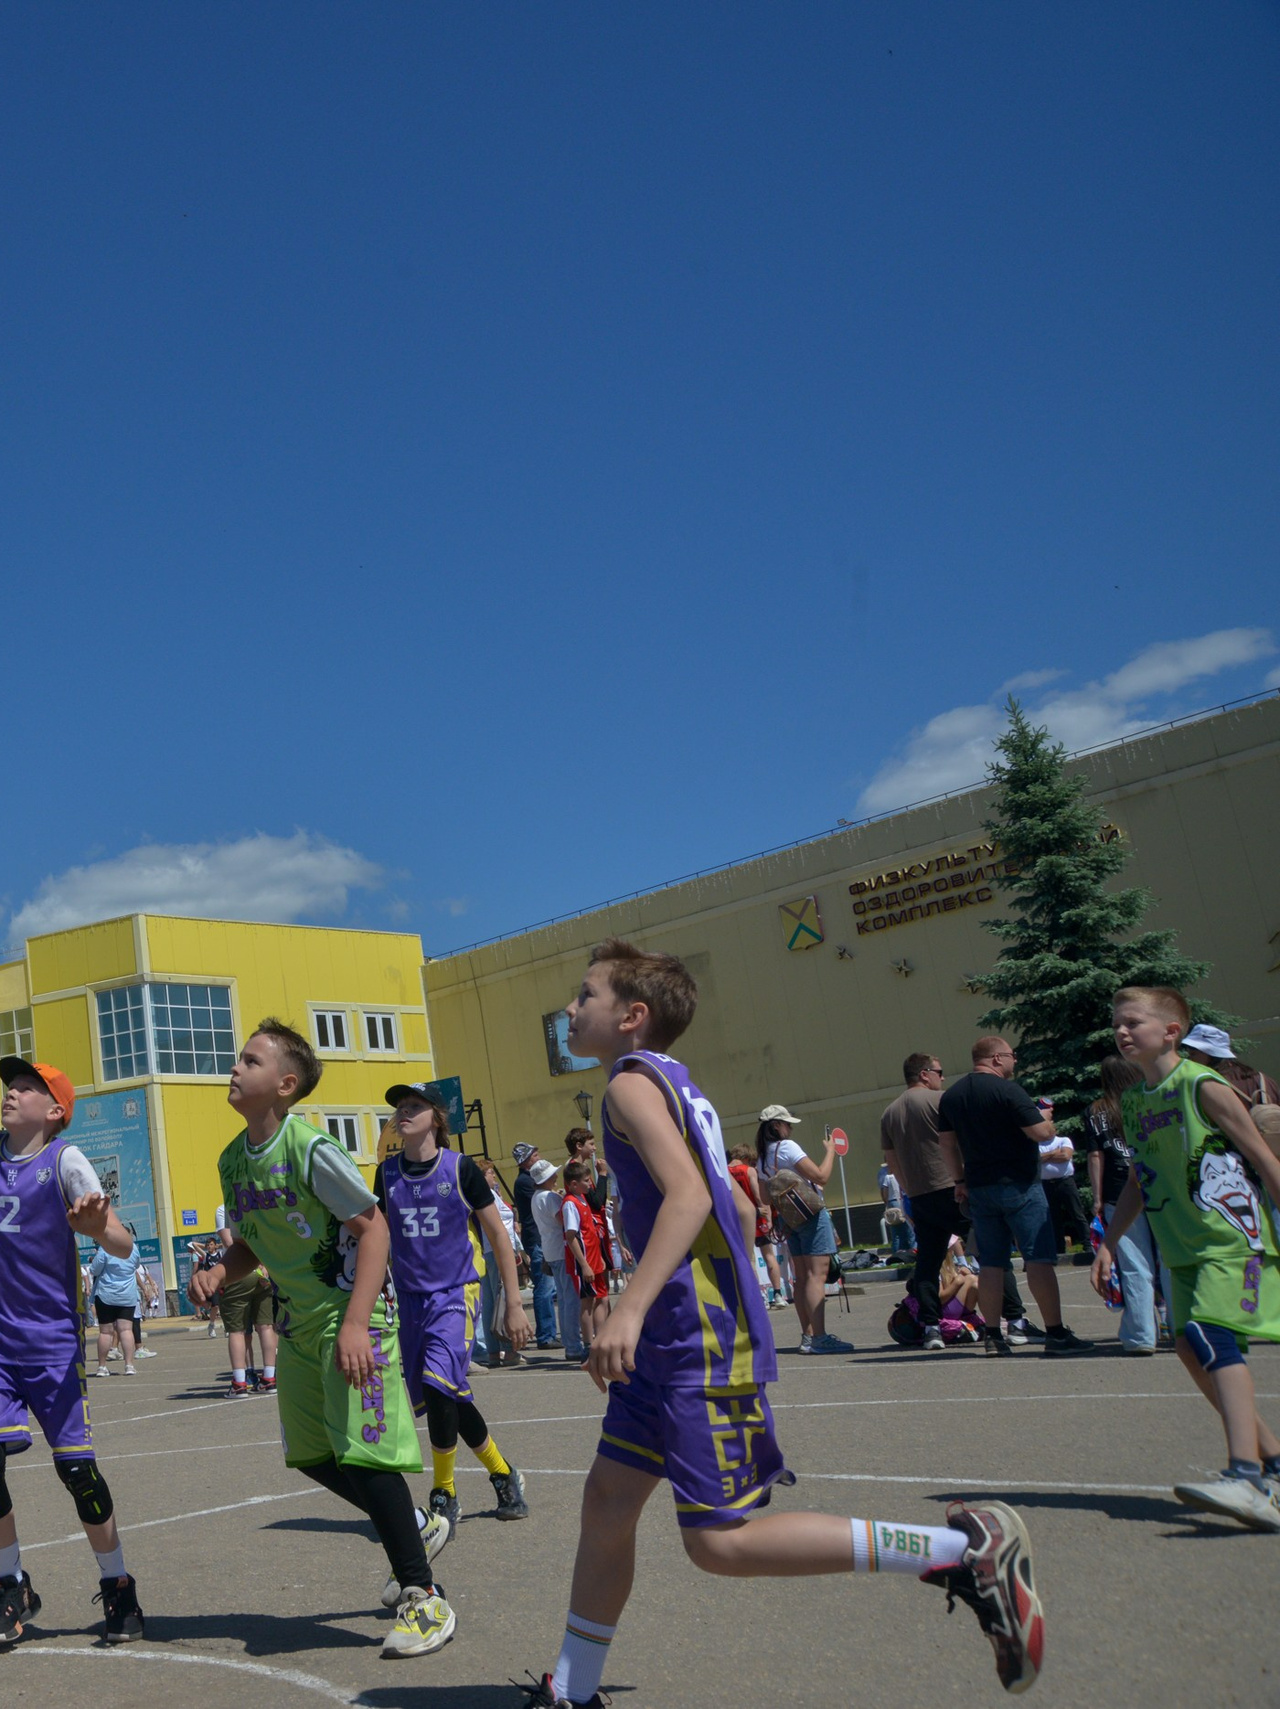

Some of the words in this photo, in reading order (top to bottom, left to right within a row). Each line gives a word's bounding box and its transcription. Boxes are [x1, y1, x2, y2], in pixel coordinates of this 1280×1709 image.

[848, 840, 1002, 897] ФИЗКУЛЬТУ
[855, 886, 994, 936] КОМПЛЕКС
[93, 1141, 123, 1150] ГАЙДАРА
[286, 1210, 313, 1239] 3
[399, 1206, 441, 1238] 33
[881, 1526, 931, 1559] 1984
